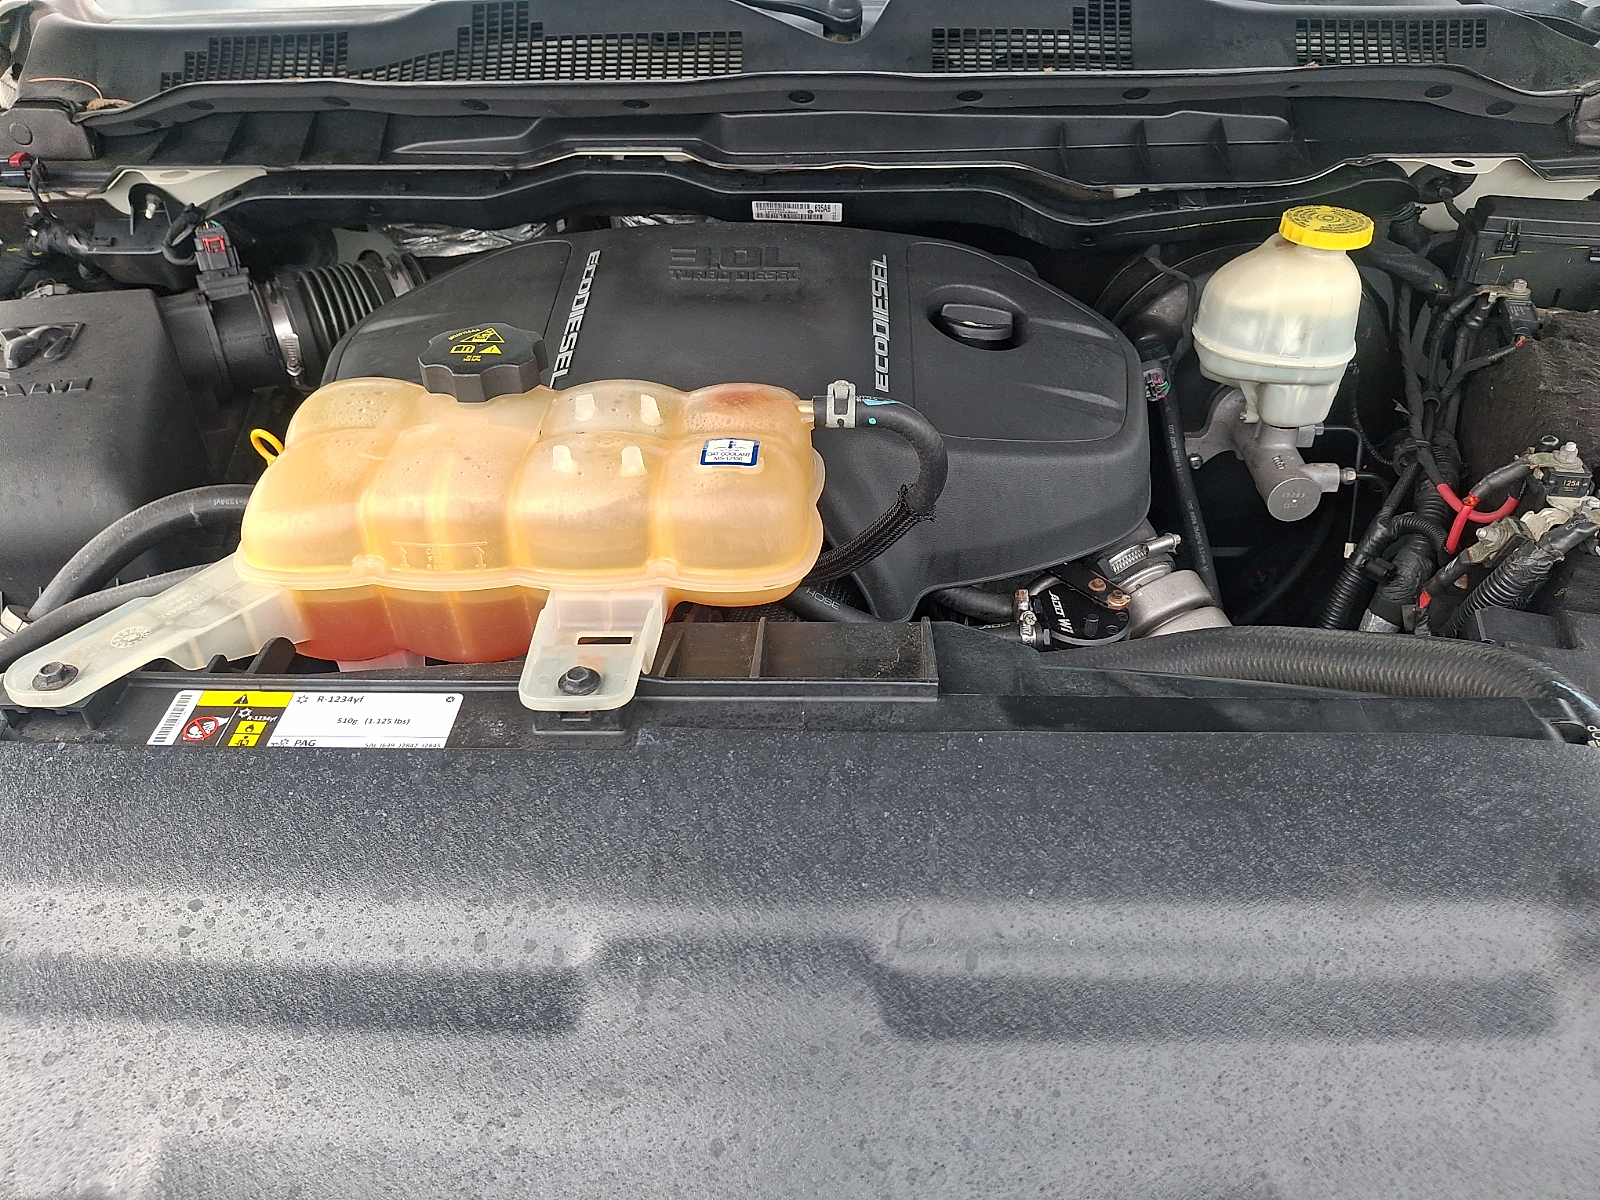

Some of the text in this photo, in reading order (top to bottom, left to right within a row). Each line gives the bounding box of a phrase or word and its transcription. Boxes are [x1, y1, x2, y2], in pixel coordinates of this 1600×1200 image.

[549, 249, 601, 389] ECODIESEL
[872, 254, 890, 393] ECODIESEL
[806, 587, 841, 611] HOSE
[316, 695, 365, 704] R-1234yf
[336, 717, 411, 726] 510g (1.125 lbs)
[293, 739, 317, 747] PAG
